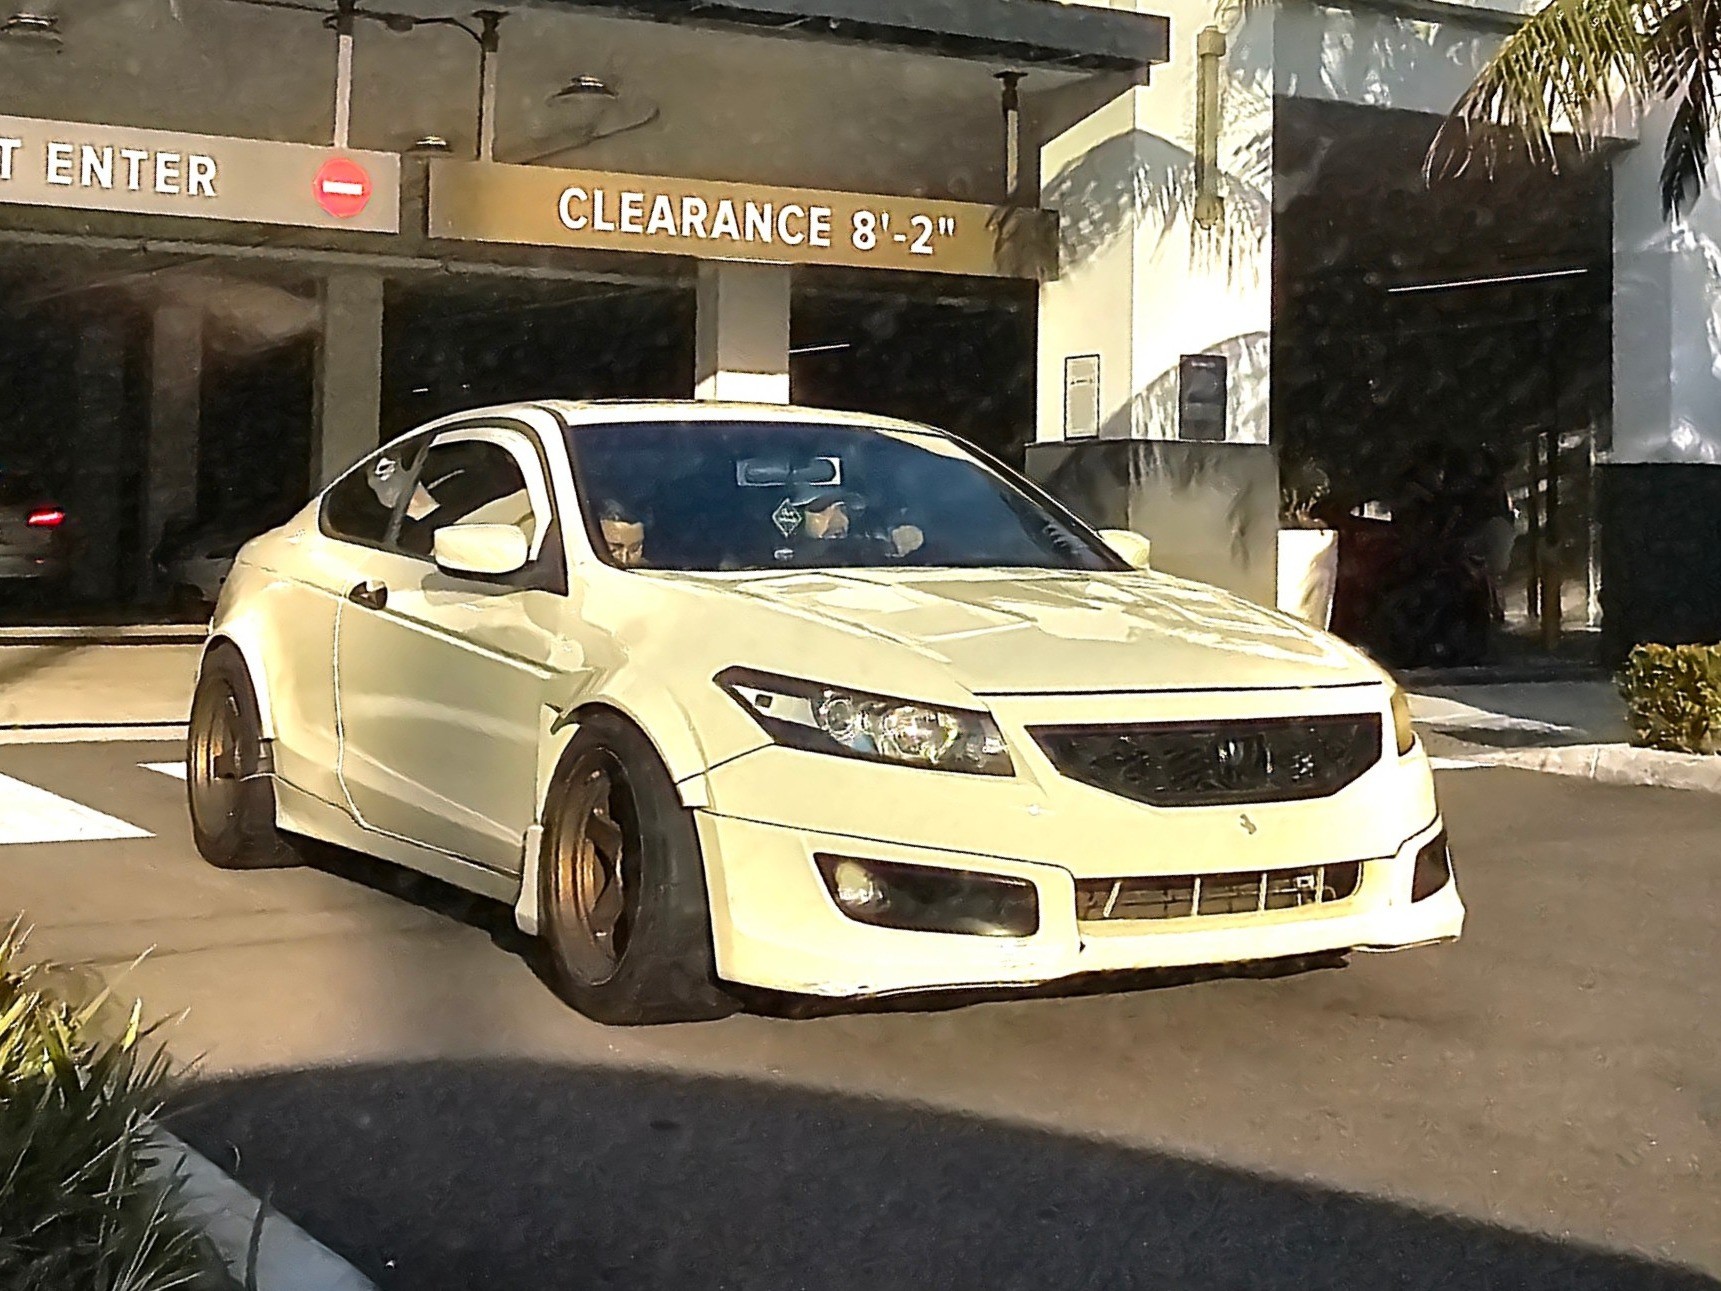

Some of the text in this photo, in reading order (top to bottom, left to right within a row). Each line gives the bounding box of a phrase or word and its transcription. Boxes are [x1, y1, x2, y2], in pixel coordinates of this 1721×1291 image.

[47, 142, 217, 197] ENTER
[559, 187, 955, 255] CLEARANCE 8'-2"
